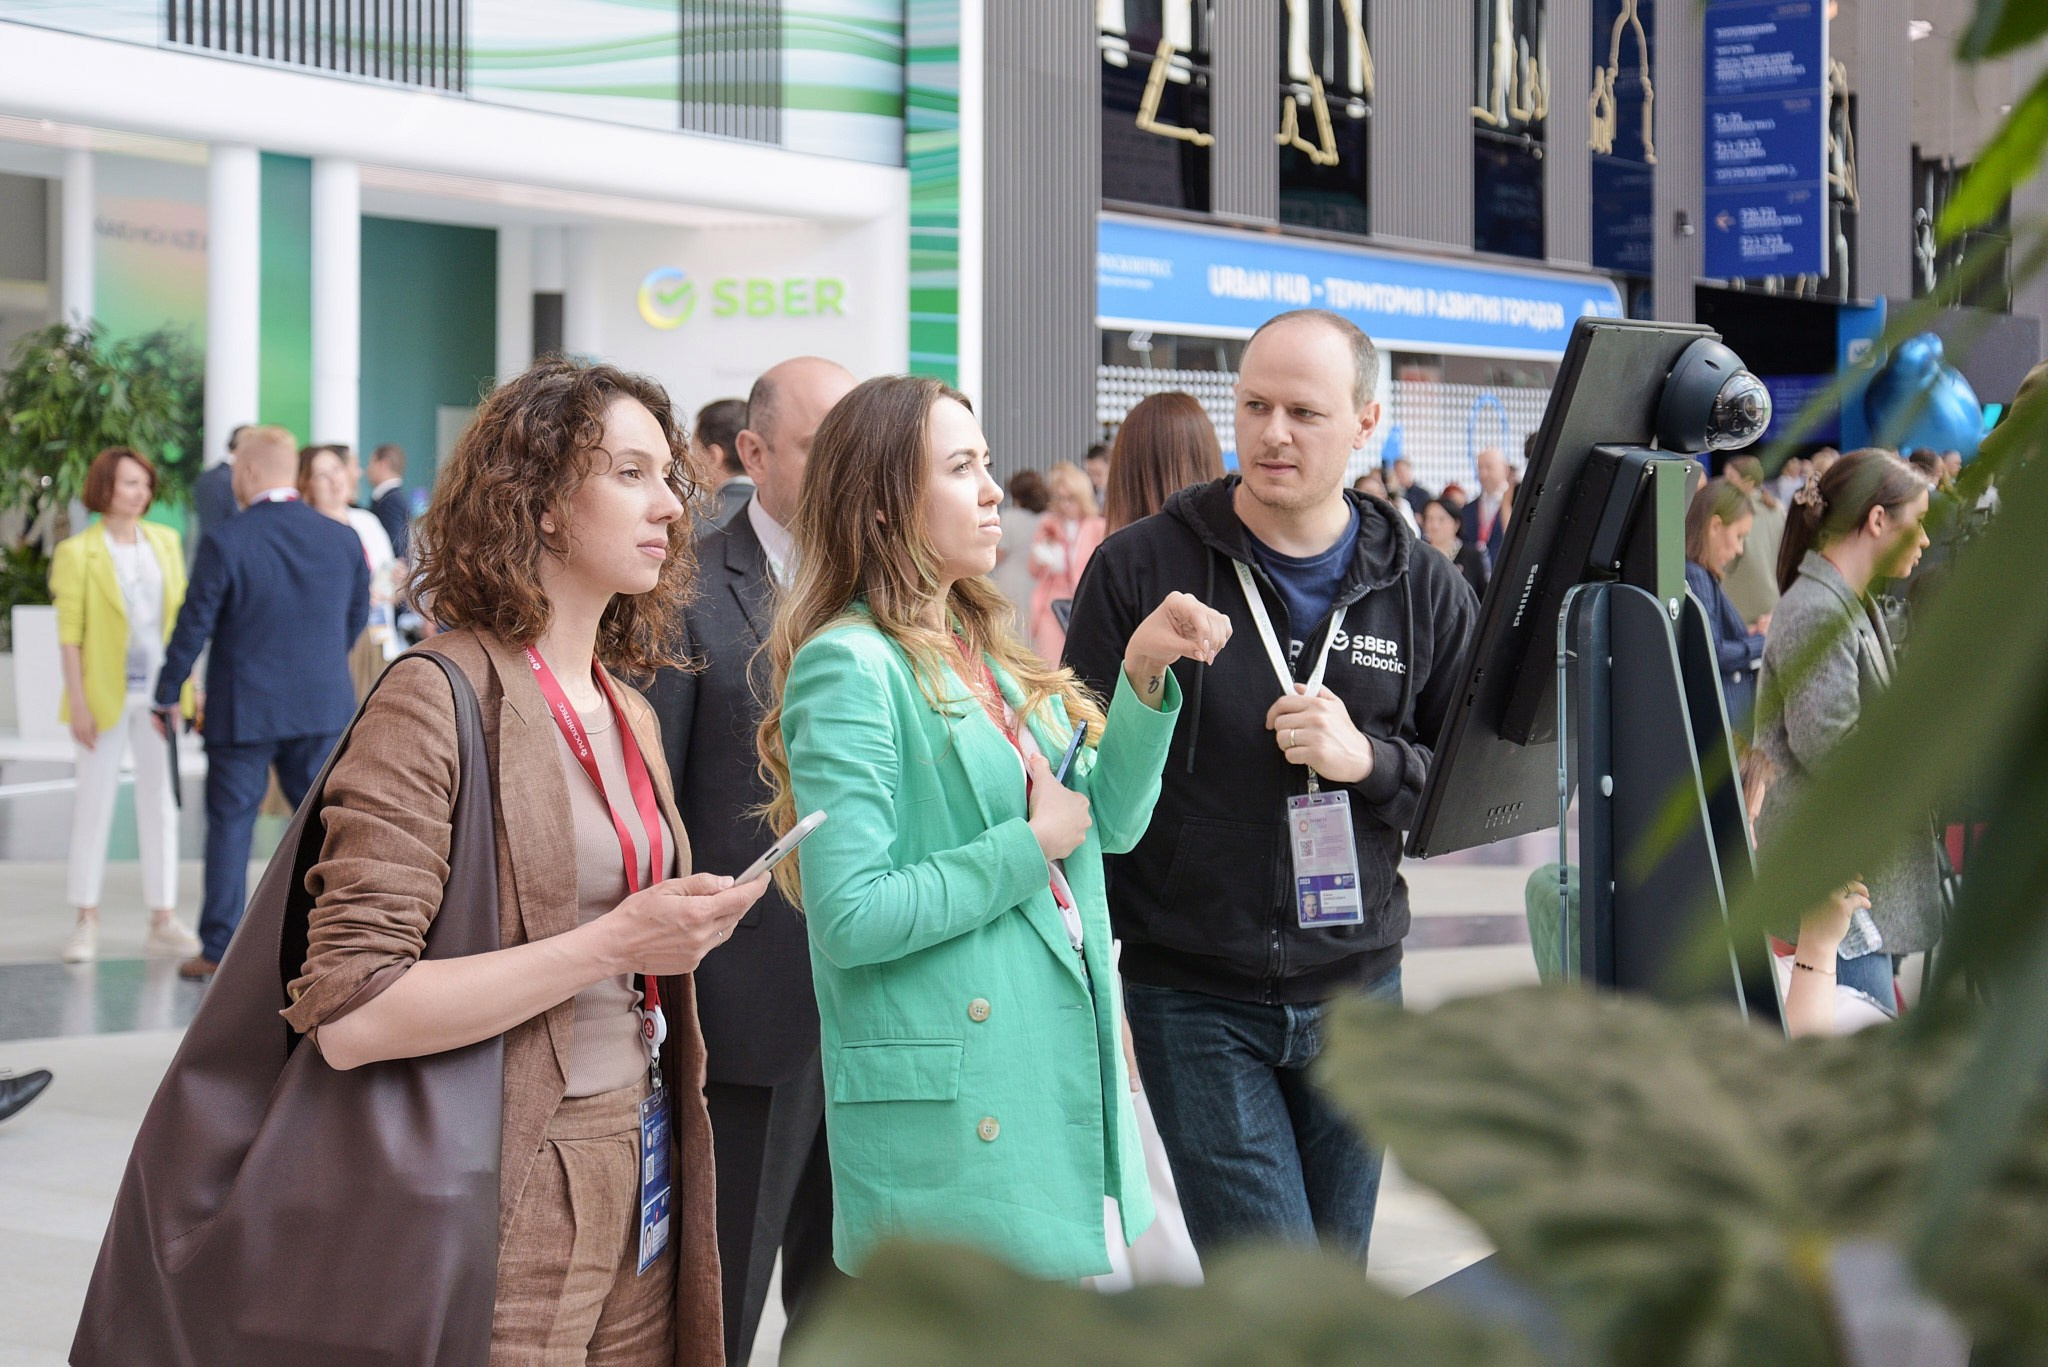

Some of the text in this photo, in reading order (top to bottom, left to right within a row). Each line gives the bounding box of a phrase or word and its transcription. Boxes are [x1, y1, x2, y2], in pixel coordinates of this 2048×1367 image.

[712, 277, 846, 318] SBER
[1208, 264, 1271, 300] URBAN
[1273, 272, 1311, 305] HUB
[1324, 277, 1424, 316] ТЕРРИТОРИЯ
[1426, 288, 1500, 323] РАЗВИТИЯ
[1501, 296, 1565, 332] ГОРОДОВ
[1513, 564, 1538, 627] PHILIPS
[1352, 634, 1398, 656] SBER
[558, 702, 584, 750] РОСКОНГРЕСС
